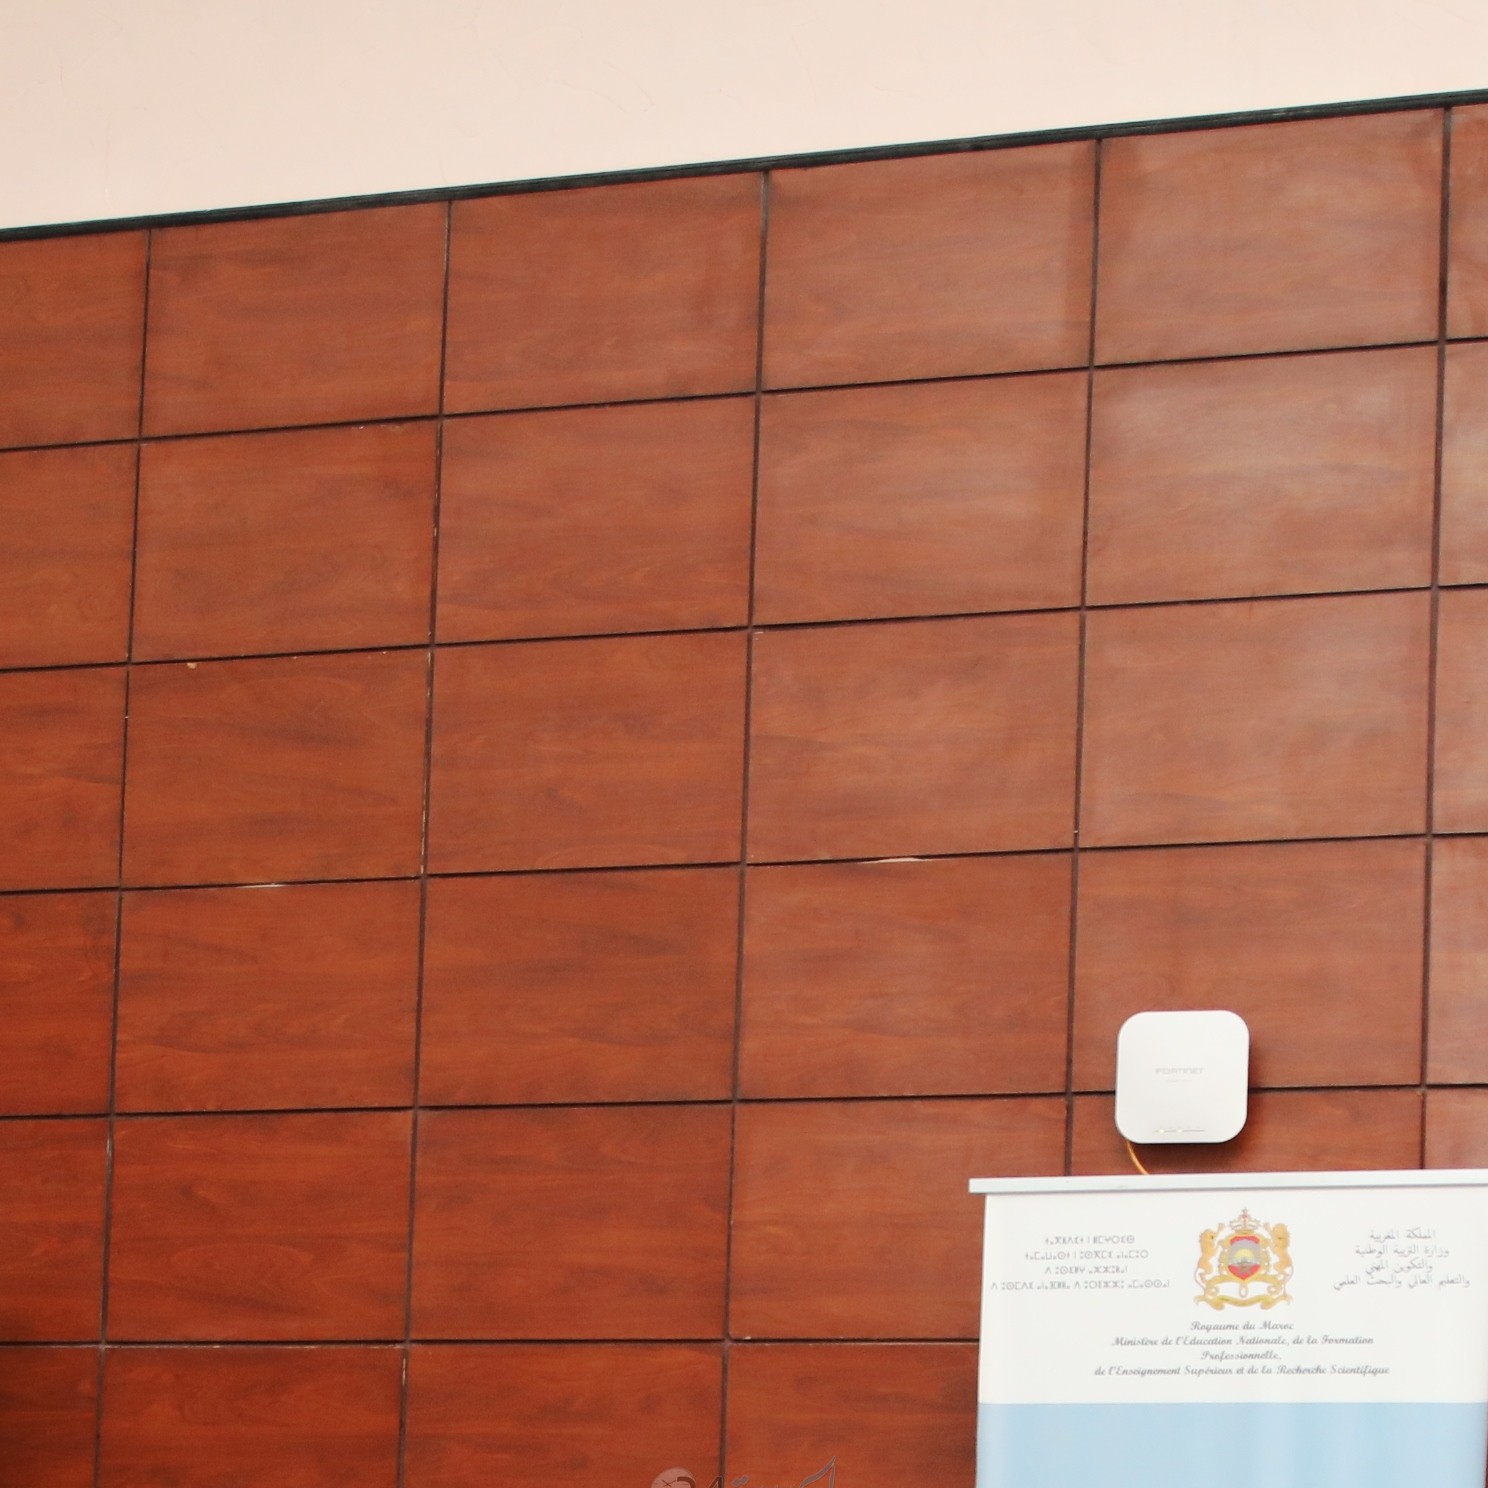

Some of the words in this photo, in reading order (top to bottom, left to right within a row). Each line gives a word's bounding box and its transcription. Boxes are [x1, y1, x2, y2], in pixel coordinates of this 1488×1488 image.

[1370, 1229, 1400, 1244] المغربية
[1406, 1226, 1436, 1240] المملكة
[1355, 1243, 1389, 1258] الوطنية
[1393, 1243, 1419, 1258] التربية
[1424, 1244, 1450, 1258] وزارة
[1365, 1258, 1389, 1275] المهني
[1394, 1257, 1433, 1274] والتكوين
[1333, 1274, 1361, 1291] العلمي
[1366, 1273, 1403, 1288] والبحث
[1408, 1273, 1434, 1289] العالي
[1438, 1273, 1471, 1288] والتعليم
[1190, 1320, 1239, 1333] Royaume
[1242, 1320, 1256, 1330] du
[1258, 1320, 1294, 1331] Maroc
[1161, 1336, 1173, 1346] de
[1235, 1335, 1290, 1347] Nationale,
[1292, 1335, 1304, 1345] de
[1306, 1335, 1318, 1345] la
[1320, 1334, 1374, 1345] Formation
[1200, 1350, 1282, 1363] Professionnelle,
[1094, 1366, 1106, 1376] de
[1183, 1364, 1233, 1377] Supérieur
[1236, 1365, 1245, 1375] et
[1247, 1364, 1259, 1375] de
[1261, 1364, 1273, 1375] la
[1276, 1364, 1327, 1375] Recherche
[1330, 1363, 1390, 1377] Scientifique
